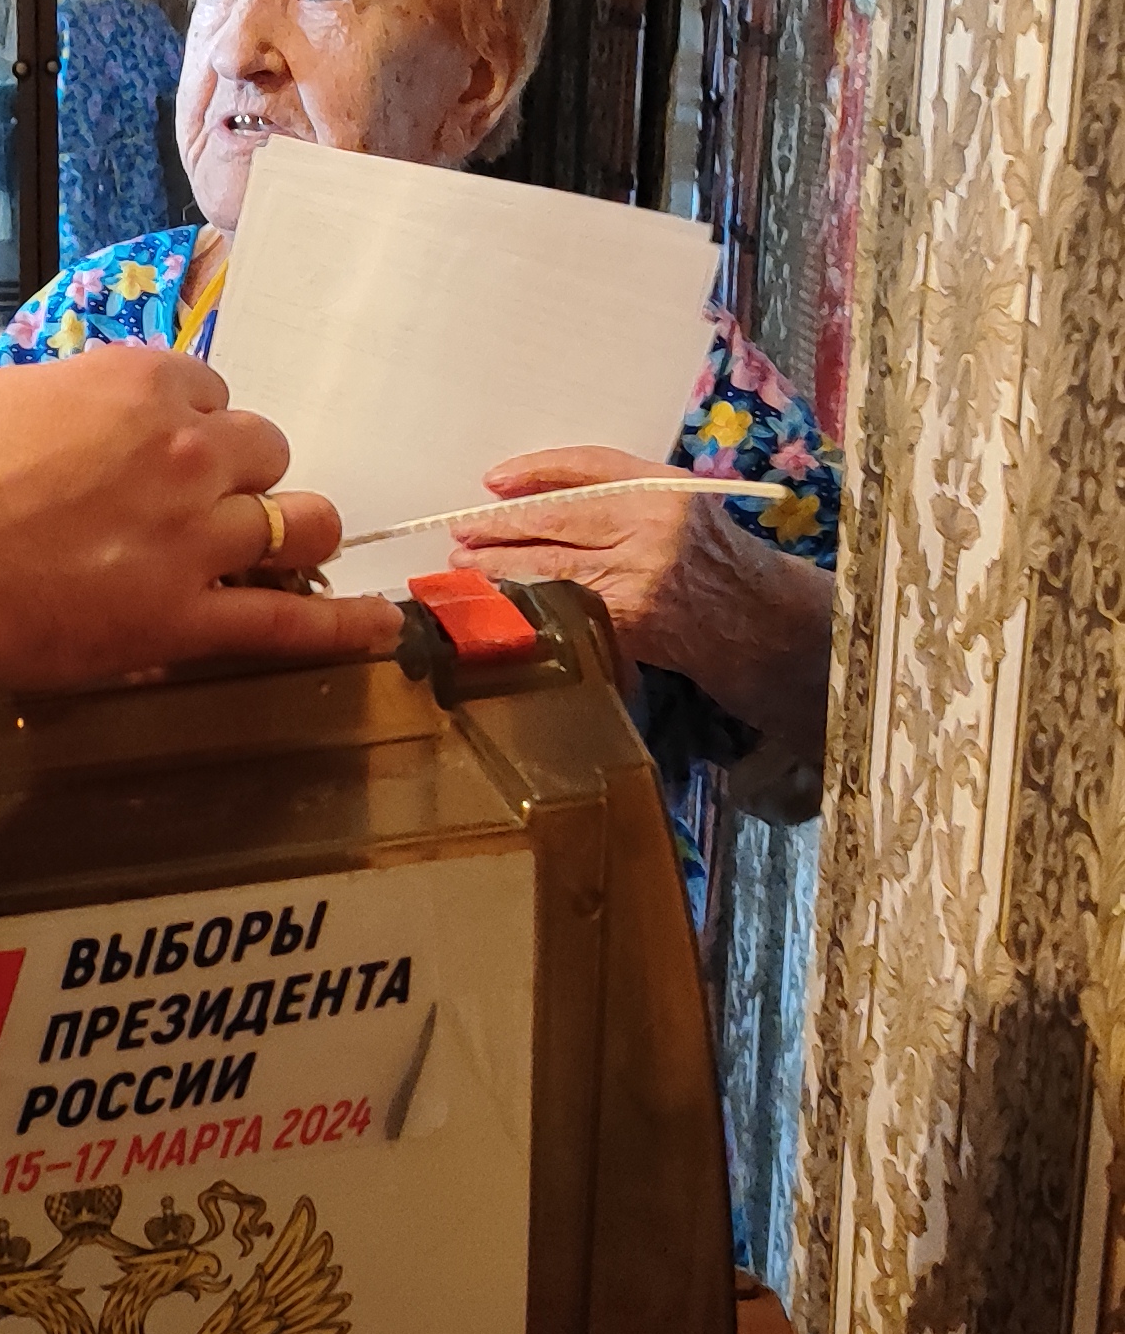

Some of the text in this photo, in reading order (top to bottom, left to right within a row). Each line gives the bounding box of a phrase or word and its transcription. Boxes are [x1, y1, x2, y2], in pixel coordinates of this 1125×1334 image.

[61, 900, 328, 990] ВЫБОРЫ
[39, 956, 412, 1065] ПРЕЗИДЕНТА
[16, 1052, 257, 1135] РОССИИ
[123, 1115, 262, 1175] МАРТА
[274, 1097, 372, 1150] 2024
